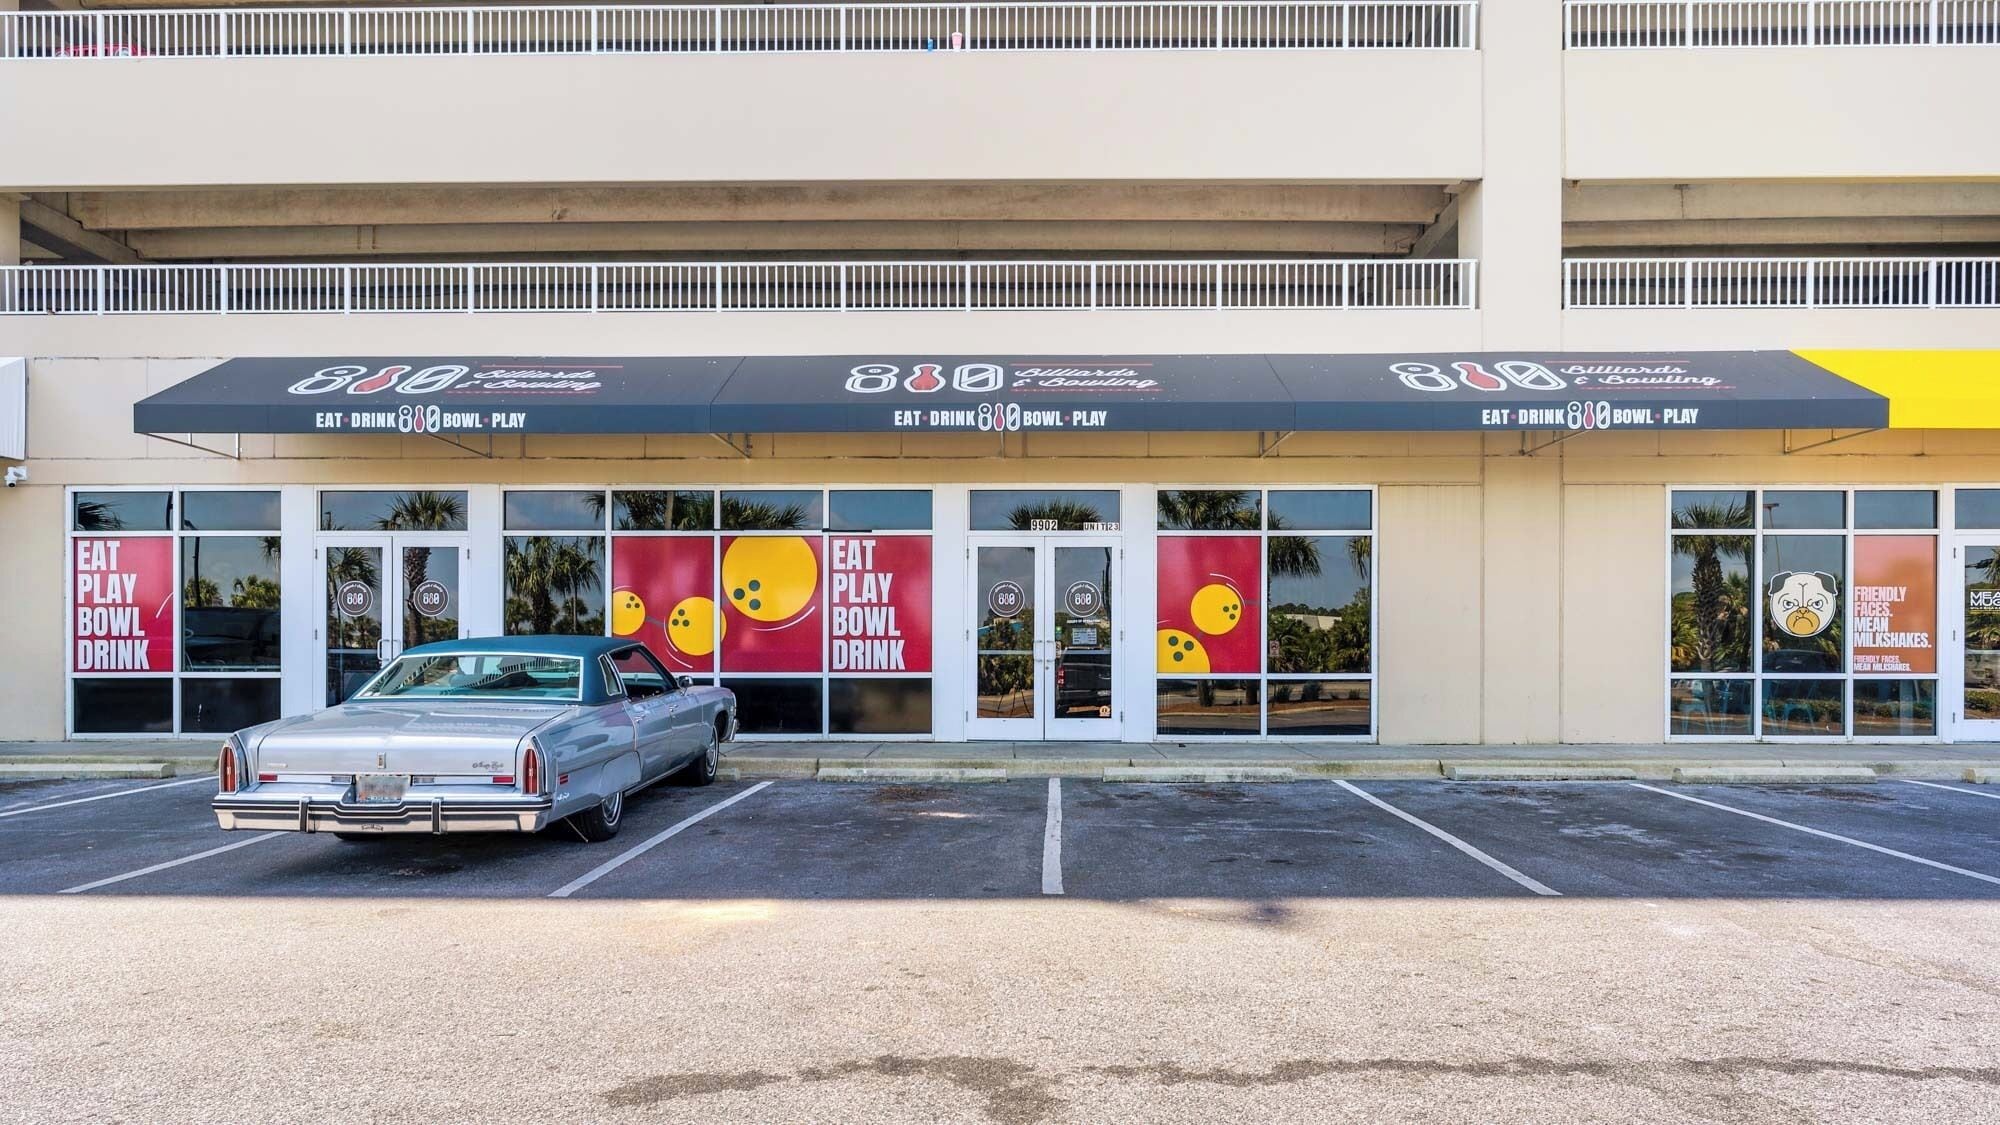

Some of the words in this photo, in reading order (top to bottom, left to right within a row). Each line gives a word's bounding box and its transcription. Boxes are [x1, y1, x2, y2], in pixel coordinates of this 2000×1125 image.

[473, 369, 596, 379] Billiards
[1014, 367, 1139, 377] Billiards
[1560, 365, 1688, 375] Billiards
[483, 379, 602, 391] Bowling
[1011, 378, 1026, 388] &
[1038, 376, 1159, 388] Bowling
[1573, 375, 1588, 385] &
[1599, 375, 1722, 387] Bowling
[316, 412, 343, 428] EAT
[351, 412, 396, 428] DRINK
[443, 412, 483, 428] BOWL
[492, 412, 526, 428] PLAY
[894, 410, 922, 427] EAT
[930, 410, 976, 427] DRINK
[1023, 410, 1063, 426] BOWL
[1073, 410, 1108, 427] PLAY
[1481, 408, 1509, 425] EAT
[1518, 408, 1565, 425] DRINK
[1613, 408, 1654, 424] BOWL
[1663, 408, 1699, 424] PLAY
[1031, 519, 1058, 531] 9902
[1084, 522, 1107, 531] UNIT
[1108, 522, 1119, 531] 23
[77, 540, 121, 571] EAT
[832, 539, 877, 570] EAT
[77, 573, 137, 604] PLAY
[832, 572, 893, 603] PLAY
[1854, 586, 1907, 602] FRIENDLY
[1854, 601, 1893, 617] FACES.
[77, 606, 145, 637] BOWL
[832, 606, 901, 637] BOWL
[1854, 616, 1889, 632] MEAN
[1853, 632, 1932, 648] MILKSHAKES.
[77, 639, 150, 670] DRINK
[832, 639, 906, 670] DRINK
[1854, 655, 1880, 663] FRIENDLY
[1854, 663, 1871, 671] MEAN
